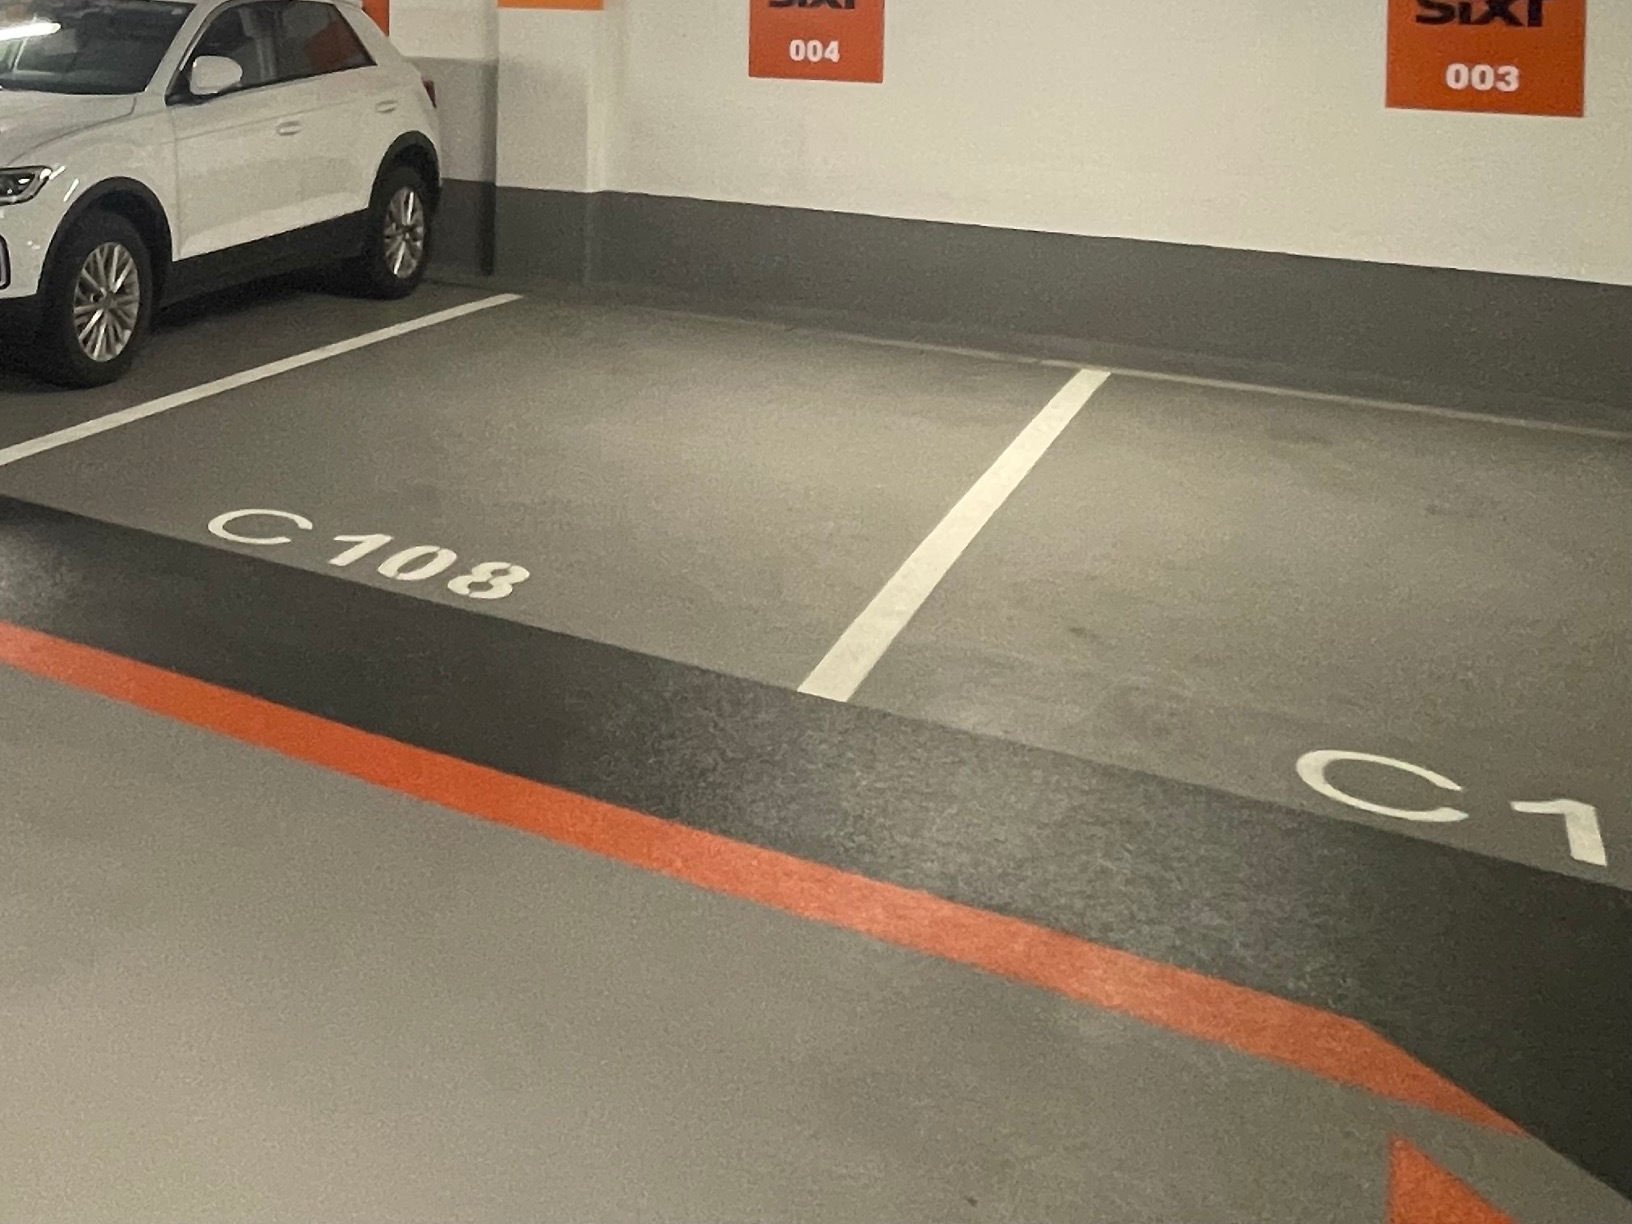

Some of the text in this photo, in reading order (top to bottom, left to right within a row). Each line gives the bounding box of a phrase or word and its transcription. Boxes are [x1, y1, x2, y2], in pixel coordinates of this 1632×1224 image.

[789, 39, 840, 63] 004
[1445, 63, 1519, 92] 003
[208, 508, 530, 599] C 108
[1296, 749, 1469, 822] C
